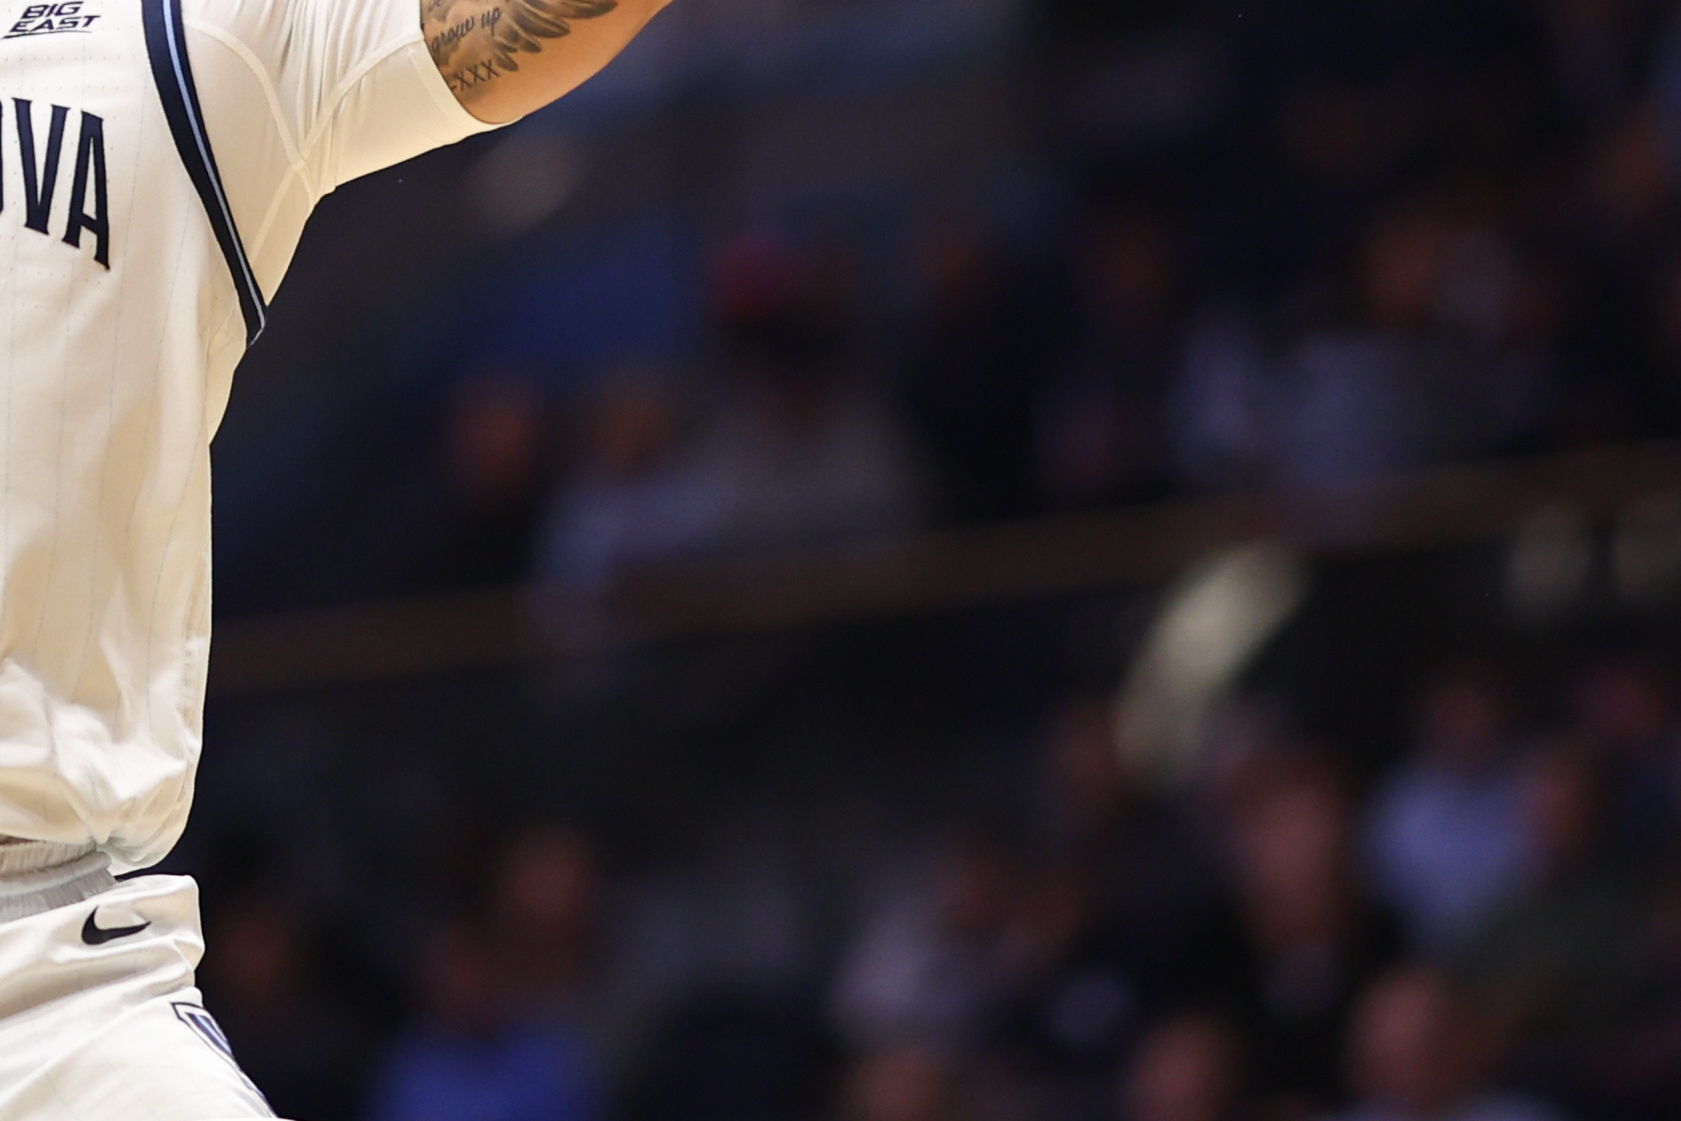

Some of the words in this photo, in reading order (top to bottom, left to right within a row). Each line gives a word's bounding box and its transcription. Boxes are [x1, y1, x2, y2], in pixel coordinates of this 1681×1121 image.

[20, 0, 85, 20] BIG
[8, 15, 102, 33] EAST
[481, 7, 503, 37] up
